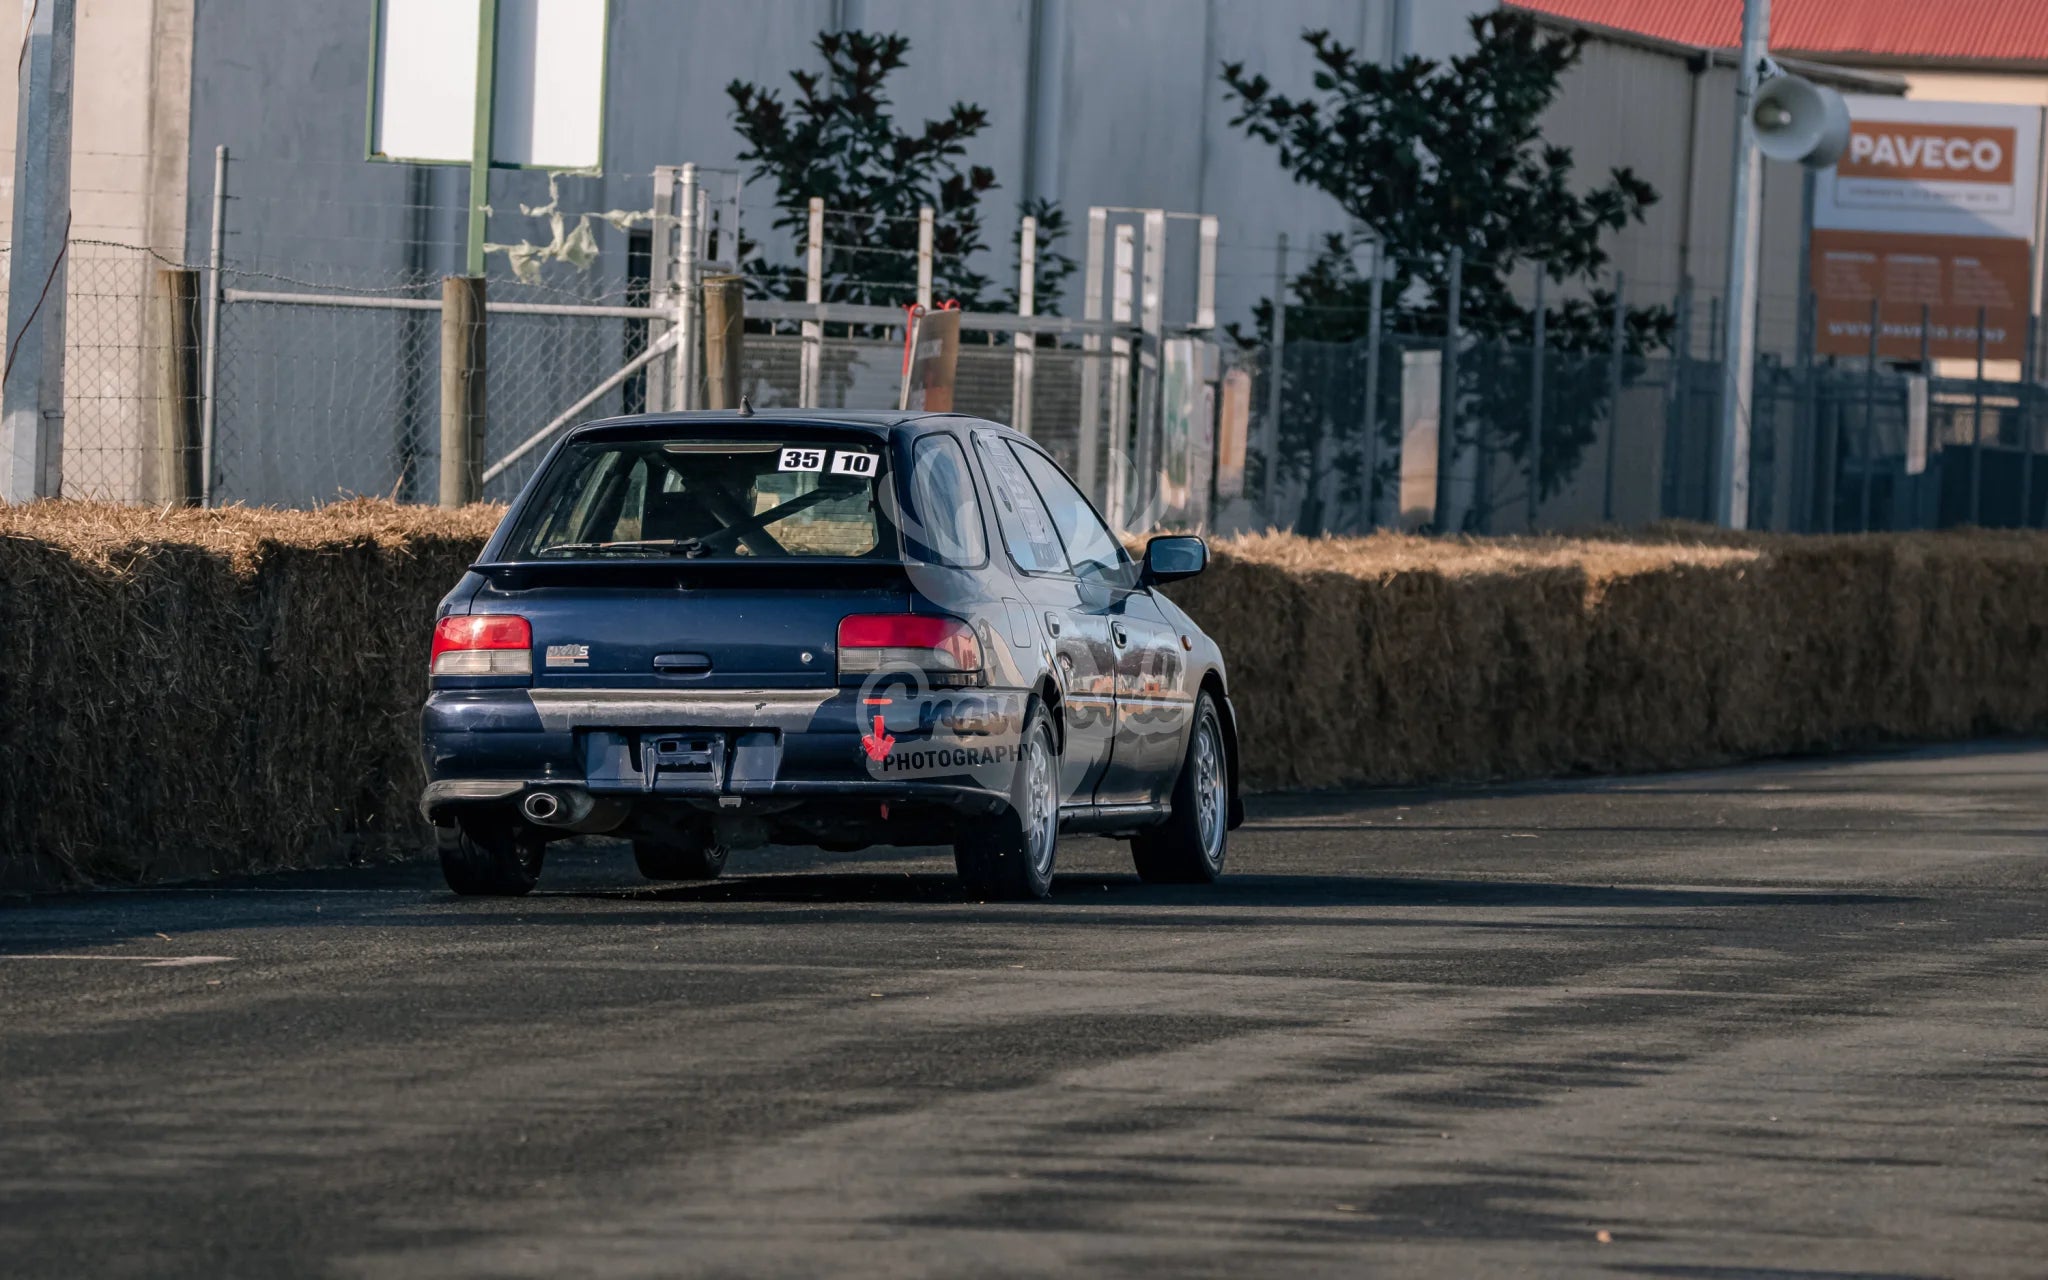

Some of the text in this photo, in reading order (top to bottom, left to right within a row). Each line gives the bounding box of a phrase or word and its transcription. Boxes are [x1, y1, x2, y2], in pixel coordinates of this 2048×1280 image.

[1851, 134, 2001, 172] PAVECO
[784, 451, 820, 469] 35
[841, 454, 871, 473] 10
